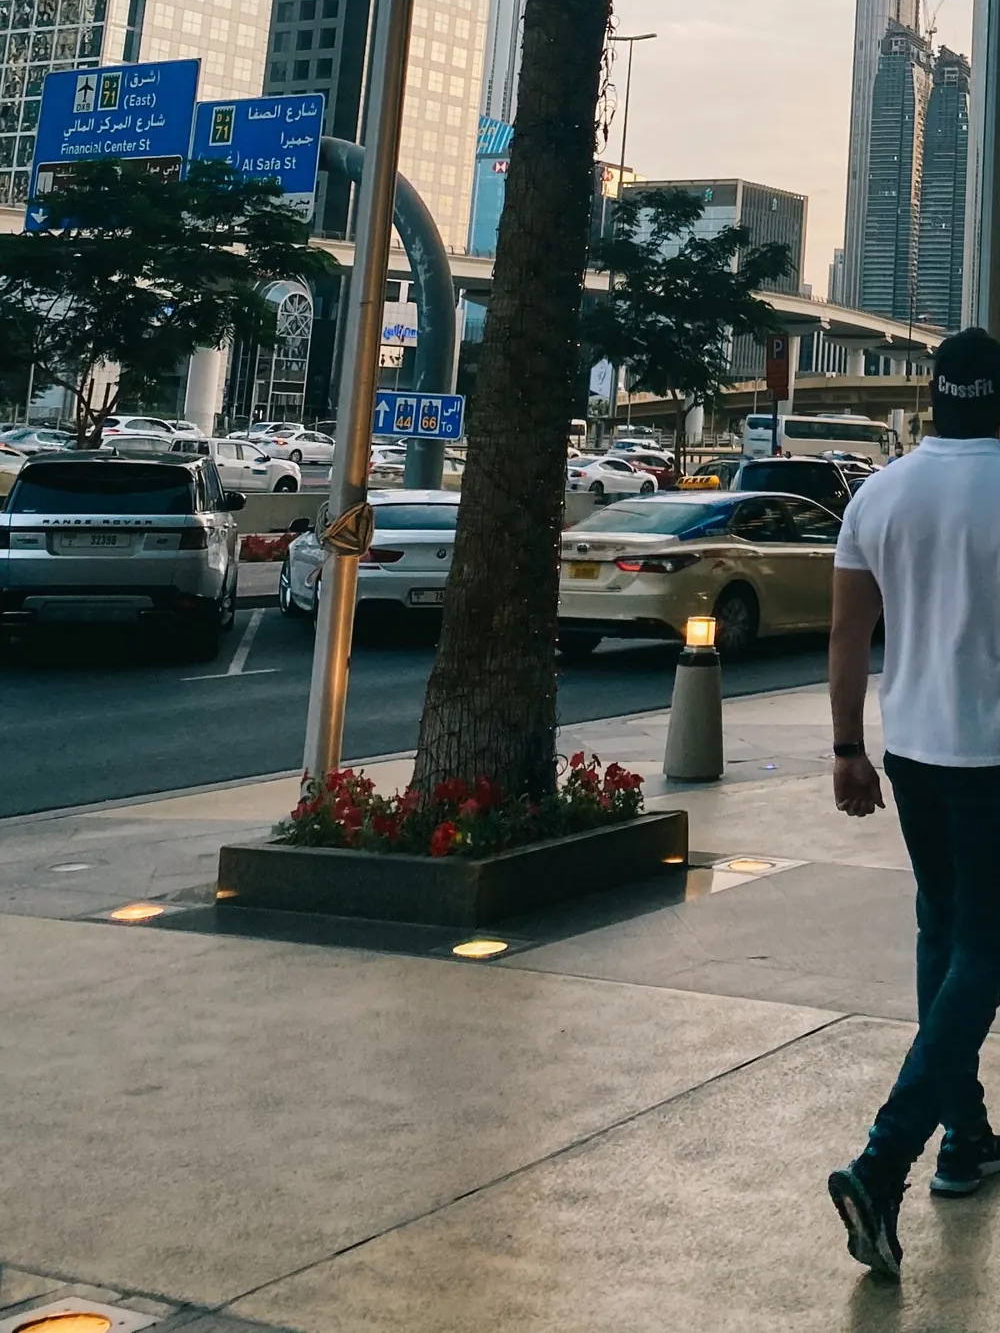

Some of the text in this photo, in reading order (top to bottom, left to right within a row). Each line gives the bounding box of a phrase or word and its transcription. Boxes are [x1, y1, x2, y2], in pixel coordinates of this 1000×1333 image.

[103, 91, 116, 106] 71
[123, 92, 157, 110] (East)
[76, 103, 91, 112] DXB
[248, 102, 318, 123] شارع الصفا
[63, 113, 166, 141] شارع المركز المالي
[215, 125, 229, 141] 71
[60, 137, 151, 156] Financial Center St
[280, 131, 314, 150] جميرا
[241, 155, 297, 172] Al Safa St
[773, 338, 783, 359] P
[938, 374, 995, 398] CrossFit
[396, 416, 411, 428] 44
[422, 416, 437, 429] 66
[441, 421, 453, 432] To
